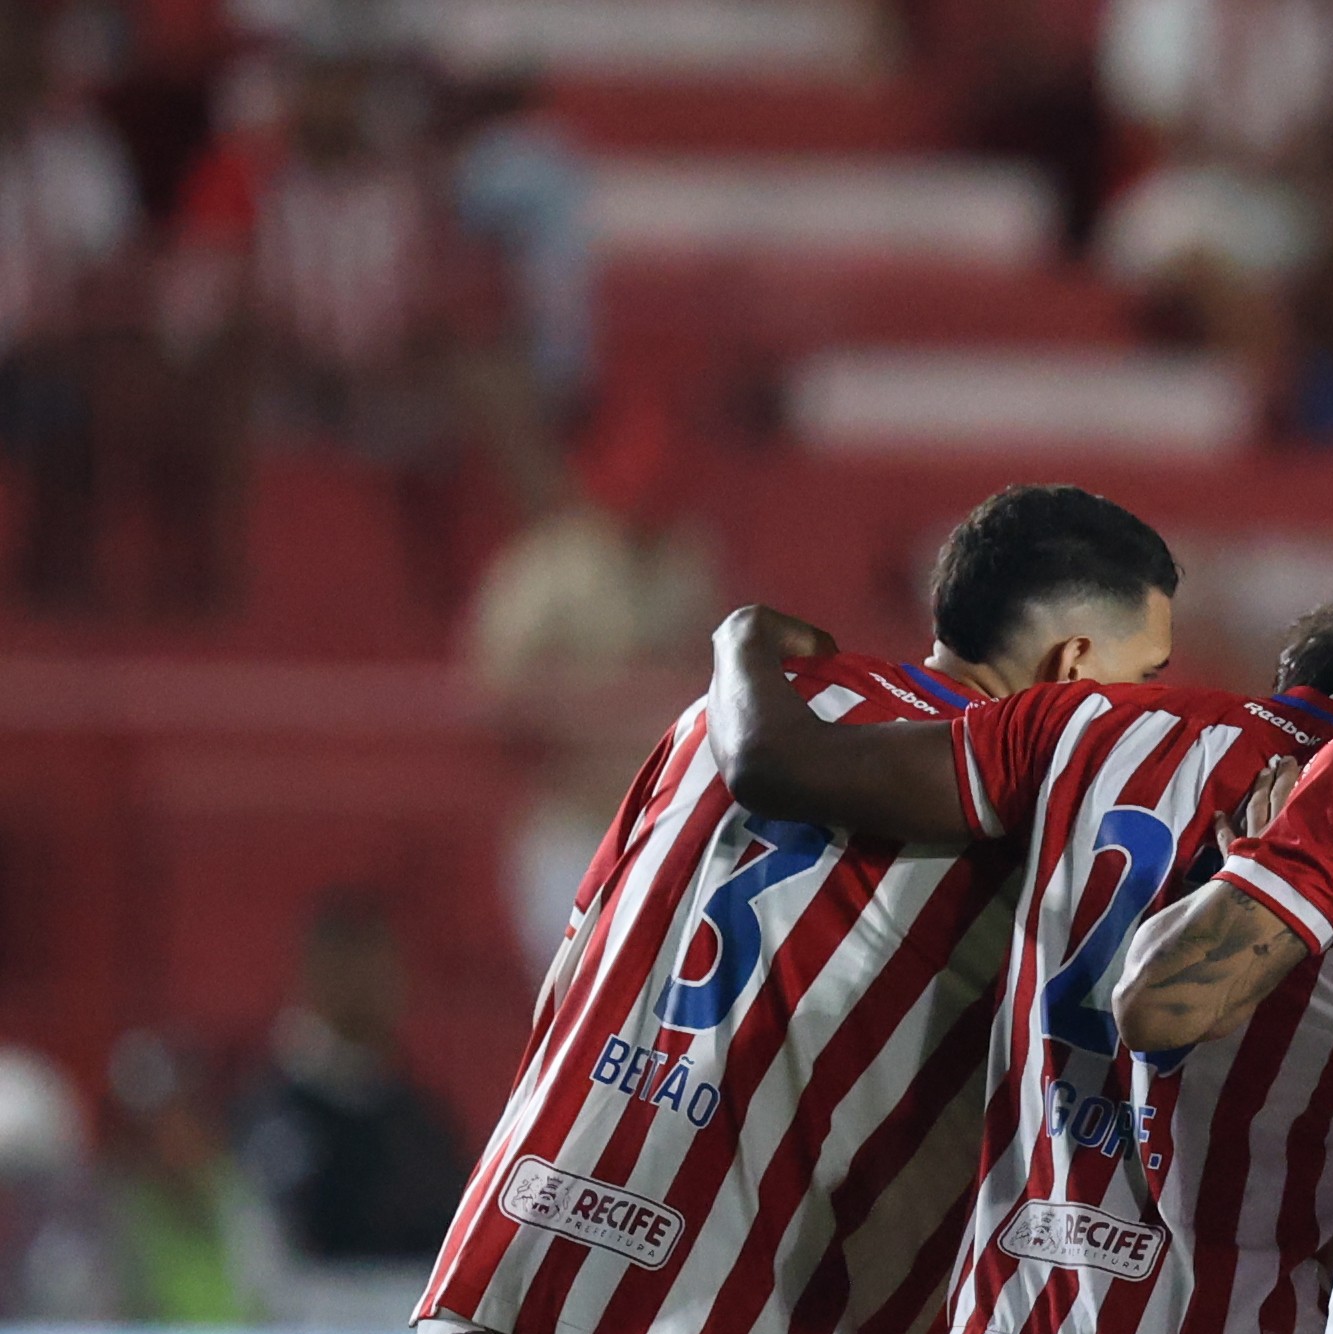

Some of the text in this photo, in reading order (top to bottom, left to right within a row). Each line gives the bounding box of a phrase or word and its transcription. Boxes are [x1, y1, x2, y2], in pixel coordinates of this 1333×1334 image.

[1243, 703, 1322, 746] Reebok
[653, 815, 835, 1032] 3
[590, 1033, 721, 1129] BETÃO
[571, 1187, 672, 1248] RECIFE
[1065, 1213, 1154, 1262] RECIFE
